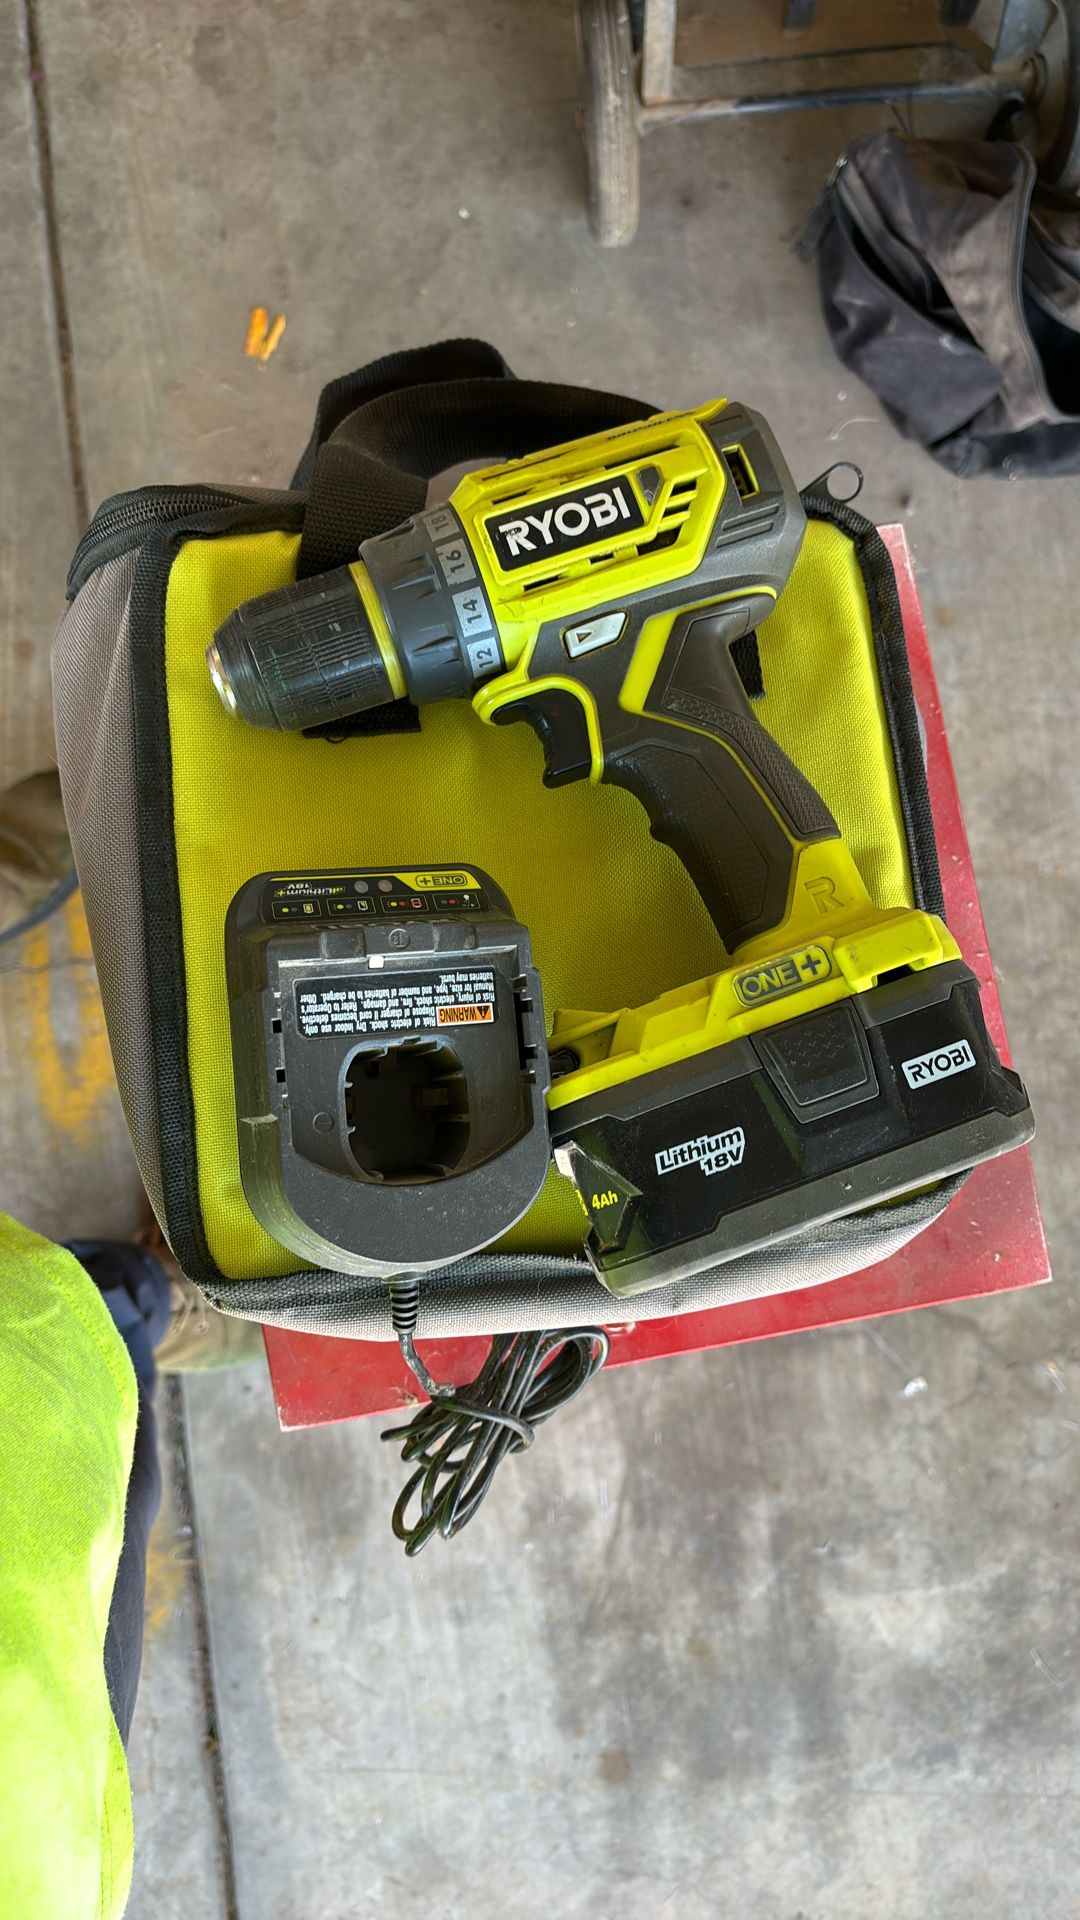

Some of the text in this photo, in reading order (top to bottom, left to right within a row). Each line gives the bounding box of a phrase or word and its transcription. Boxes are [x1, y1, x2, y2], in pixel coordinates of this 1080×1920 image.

[499, 487, 631, 556] RYOBI
[449, 550, 465, 572] 16
[463, 599, 482, 624] 14
[477, 648, 493, 668] 12
[439, 972, 493, 983] batteries may burst.
[300, 983, 494, 1003] Manual for size, type, and number of batteries to be charged. Other
[301, 992, 495, 1014] Risk of injury, electric shock, fire, and damage. Refer to Operator's
[300, 1006, 435, 1024] Dispose of charger if cord becomes defective.
[440, 1007, 476, 1023] WARNING
[303, 1017, 435, 1035] Risk of electric shock. Dry indoor use only.
[908, 1044, 972, 1085] RYOBI
[658, 1128, 742, 1170] Lithium
[703, 1147, 743, 1172] 18V
[592, 1189, 619, 1210] 4Ah
